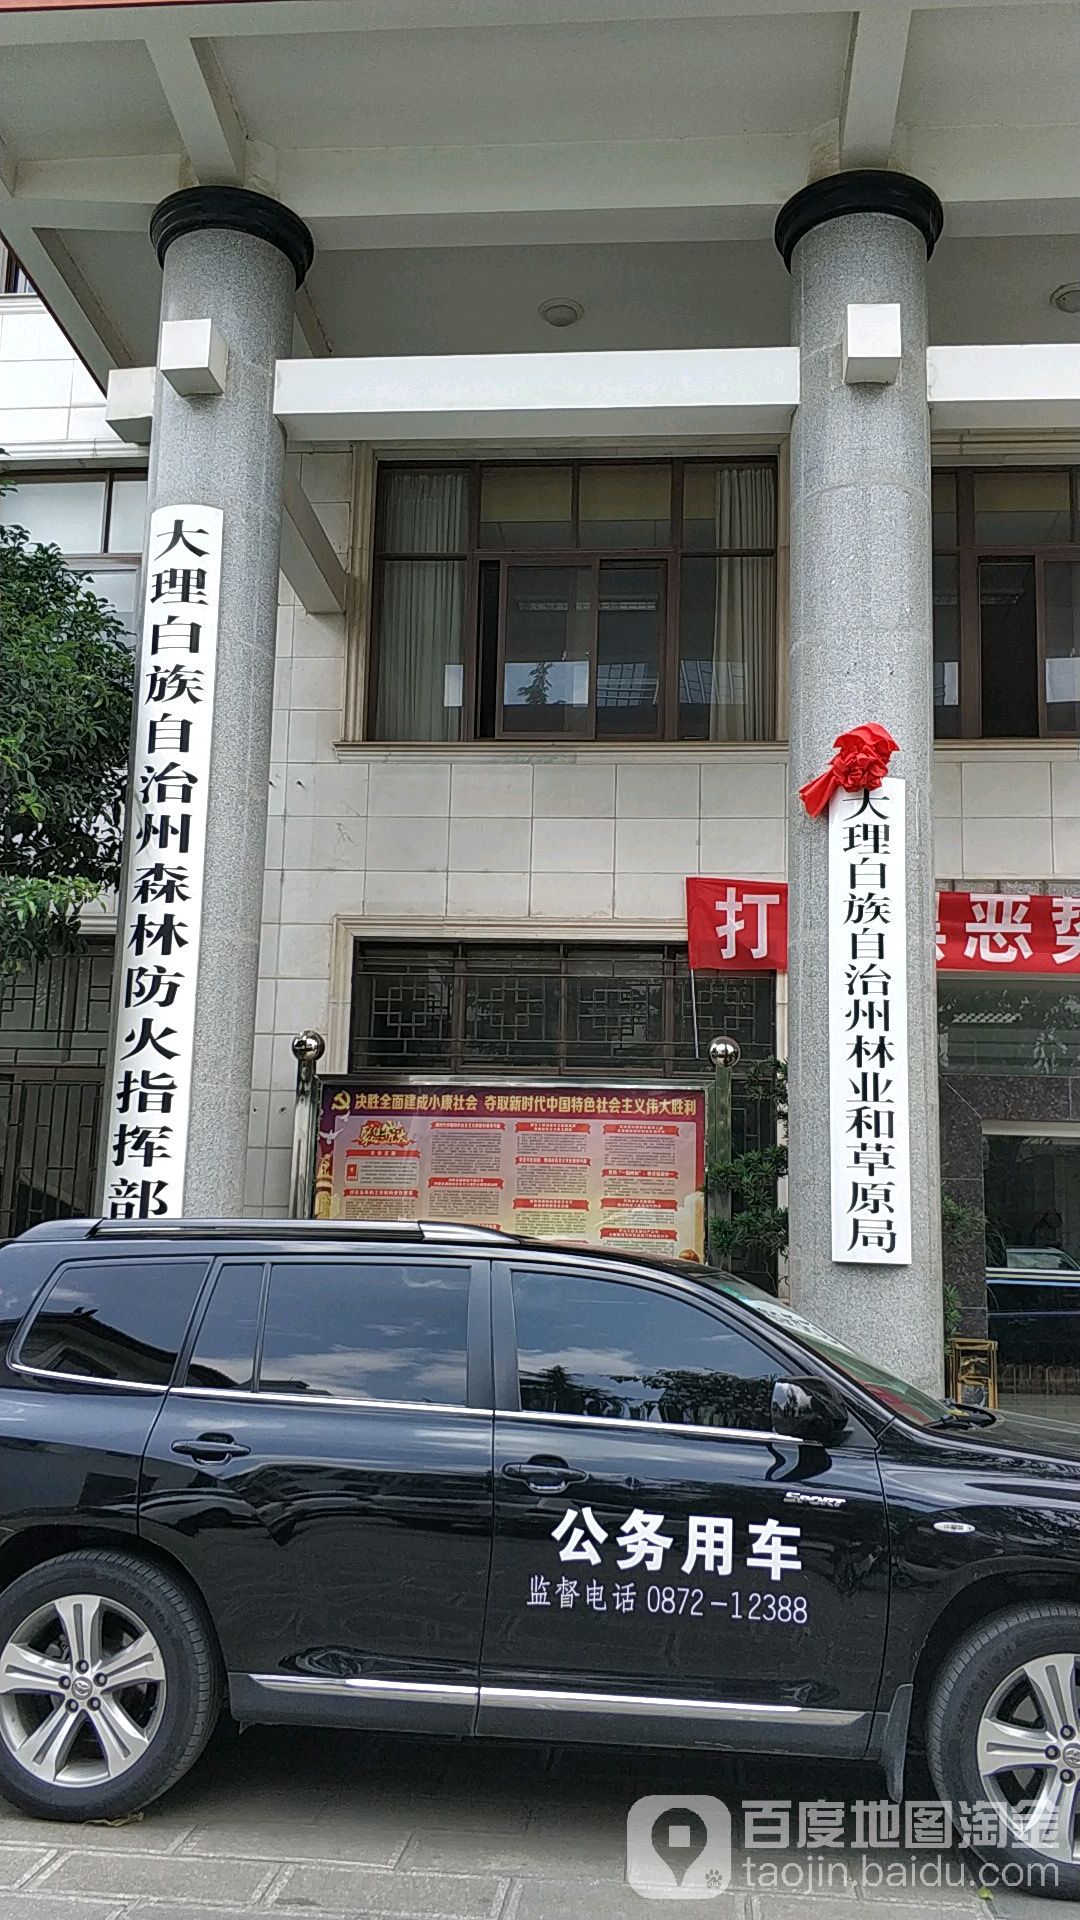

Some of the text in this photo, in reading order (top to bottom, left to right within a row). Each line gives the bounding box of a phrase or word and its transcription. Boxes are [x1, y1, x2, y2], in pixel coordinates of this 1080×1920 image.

[108, 518, 209, 1219] 大理白族自治州森林防火指挥部
[715, 886, 780, 960] 打
[842, 788, 897, 1254] 大理白族自治州林业和草原局
[355, 1093, 697, 1116] 决胜全面建成小康社会 夺取新时代中国特色社会主义伟大胜利
[551, 1506, 802, 1581] 公务用车
[527, 1575, 808, 1624] 监督电话 0872-12388
